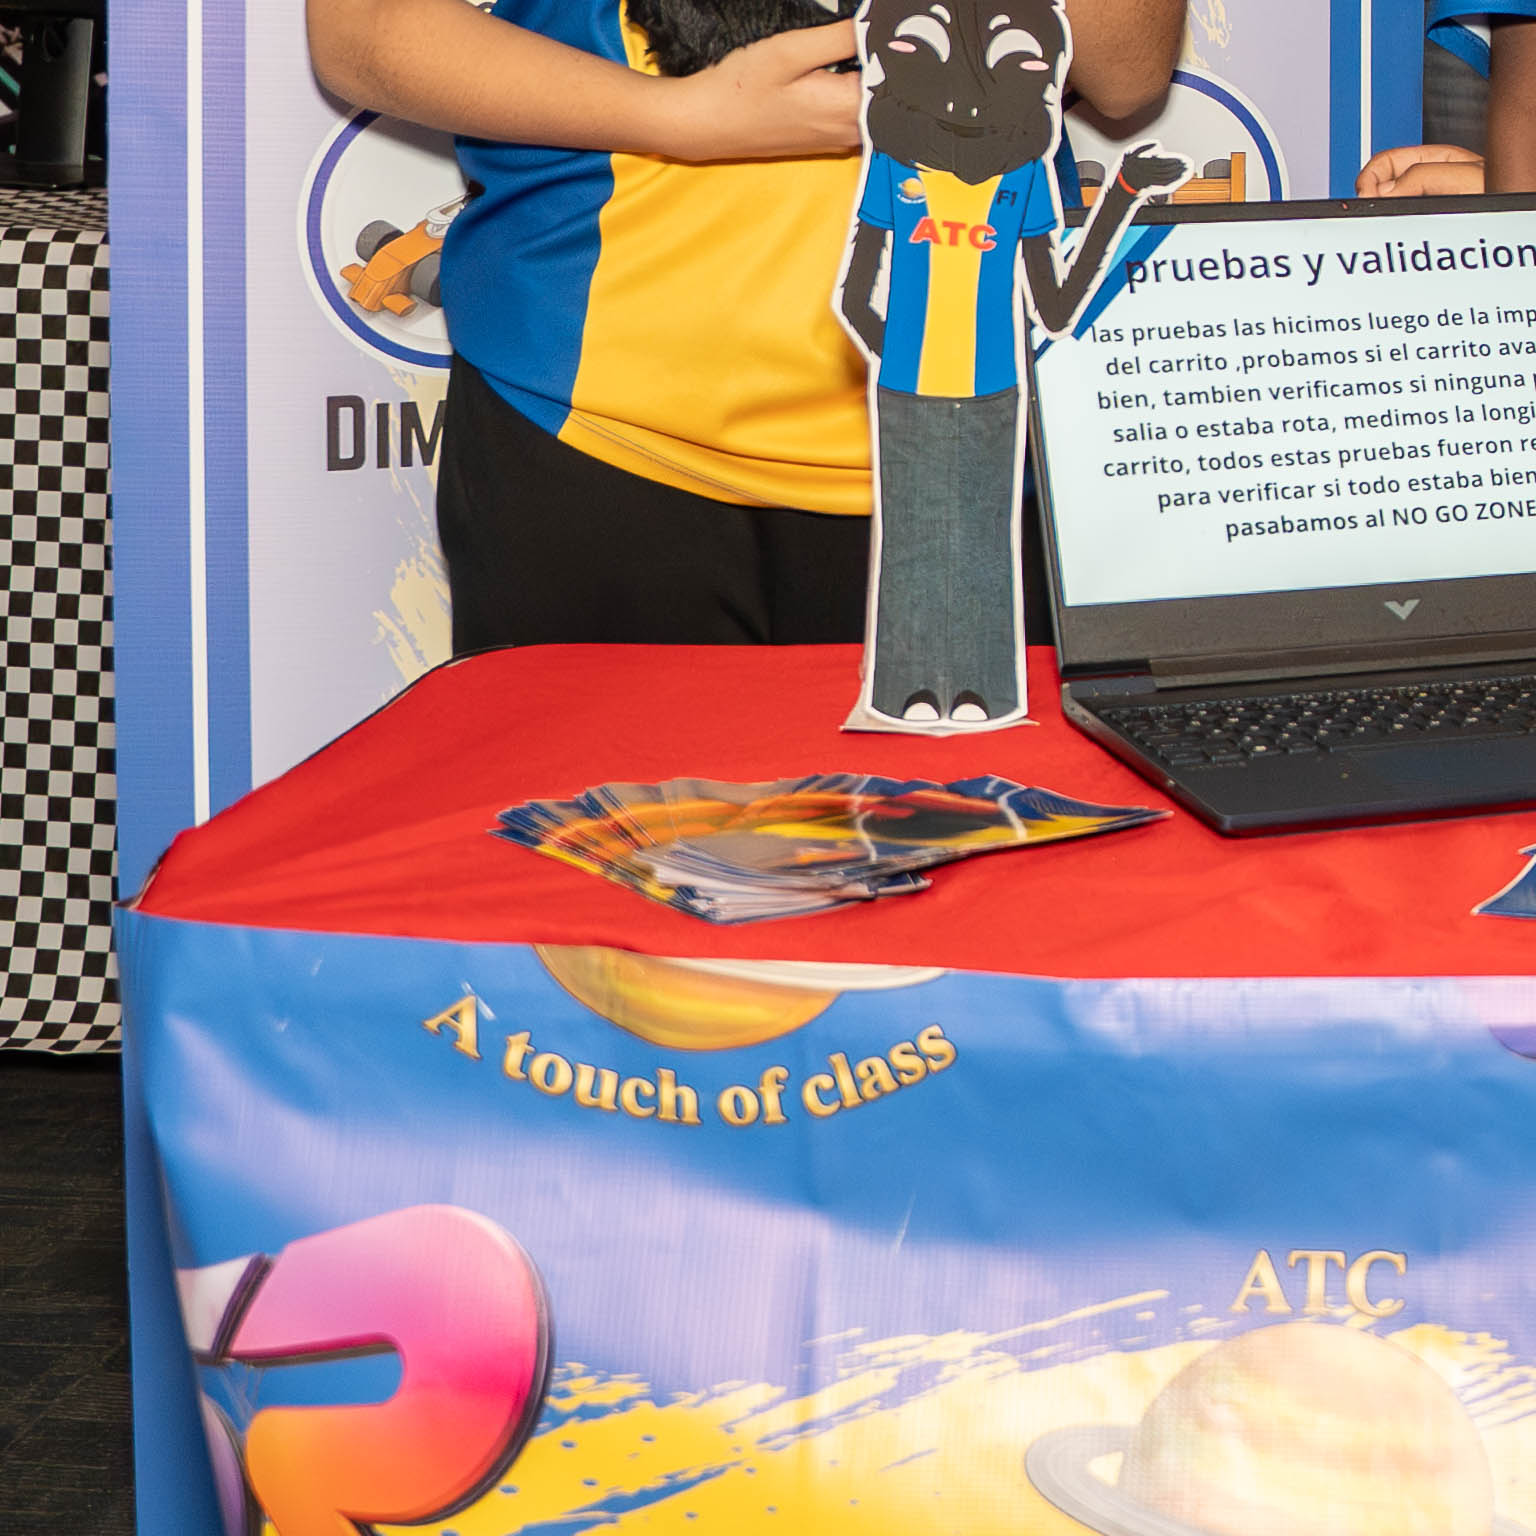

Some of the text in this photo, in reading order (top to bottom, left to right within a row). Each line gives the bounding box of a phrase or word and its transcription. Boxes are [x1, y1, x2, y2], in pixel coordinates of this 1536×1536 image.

[909, 215, 998, 252] ATC
[1126, 248, 1292, 293] pruebas
[1302, 253, 1325, 287] y
[1091, 322, 1125, 344] las
[1132, 320, 1227, 347] pruebas
[1233, 318, 1266, 337] las
[1272, 315, 1362, 335] hicimos
[1368, 312, 1430, 334] luego
[1437, 308, 1463, 327] de
[1470, 307, 1489, 325] la
[1106, 356, 1141, 376] del
[1149, 353, 1227, 374] carrito
[1365, 344, 1382, 363] si
[1389, 343, 1408, 362] el
[1416, 340, 1491, 360] carrito
[1097, 389, 1155, 410] bien,
[1163, 385, 1261, 406] tambien
[1268, 378, 1403, 401] verificamos
[1409, 374, 1427, 393] si
[1434, 371, 1526, 395] ninguna
[1113, 422, 1167, 443] salia
[1175, 425, 1188, 439] o
[1196, 417, 1274, 438] estaba
[1282, 415, 1336, 433] rota,
[1344, 407, 1449, 429] medimos
[1455, 405, 1475, 423] la
[1103, 455, 1190, 478] carrito,
[1197, 451, 1263, 472] todos
[1271, 449, 1331, 467] estas
[1338, 441, 1431, 469] pruebas
[1437, 436, 1513, 457] fueron
[1158, 491, 1211, 513] para
[1218, 481, 1316, 504] verificar
[1323, 480, 1341, 498] si
[1347, 475, 1400, 496] todo
[1408, 471, 1483, 492] estaba
[1226, 515, 1358, 543] pasabamos
[1365, 508, 1385, 528] al
[1392, 506, 1428, 526] NO
[1435, 504, 1468, 523] GO
[423, 993, 959, 1127] A touch of class
[1230, 1247, 1409, 1318] ATC
